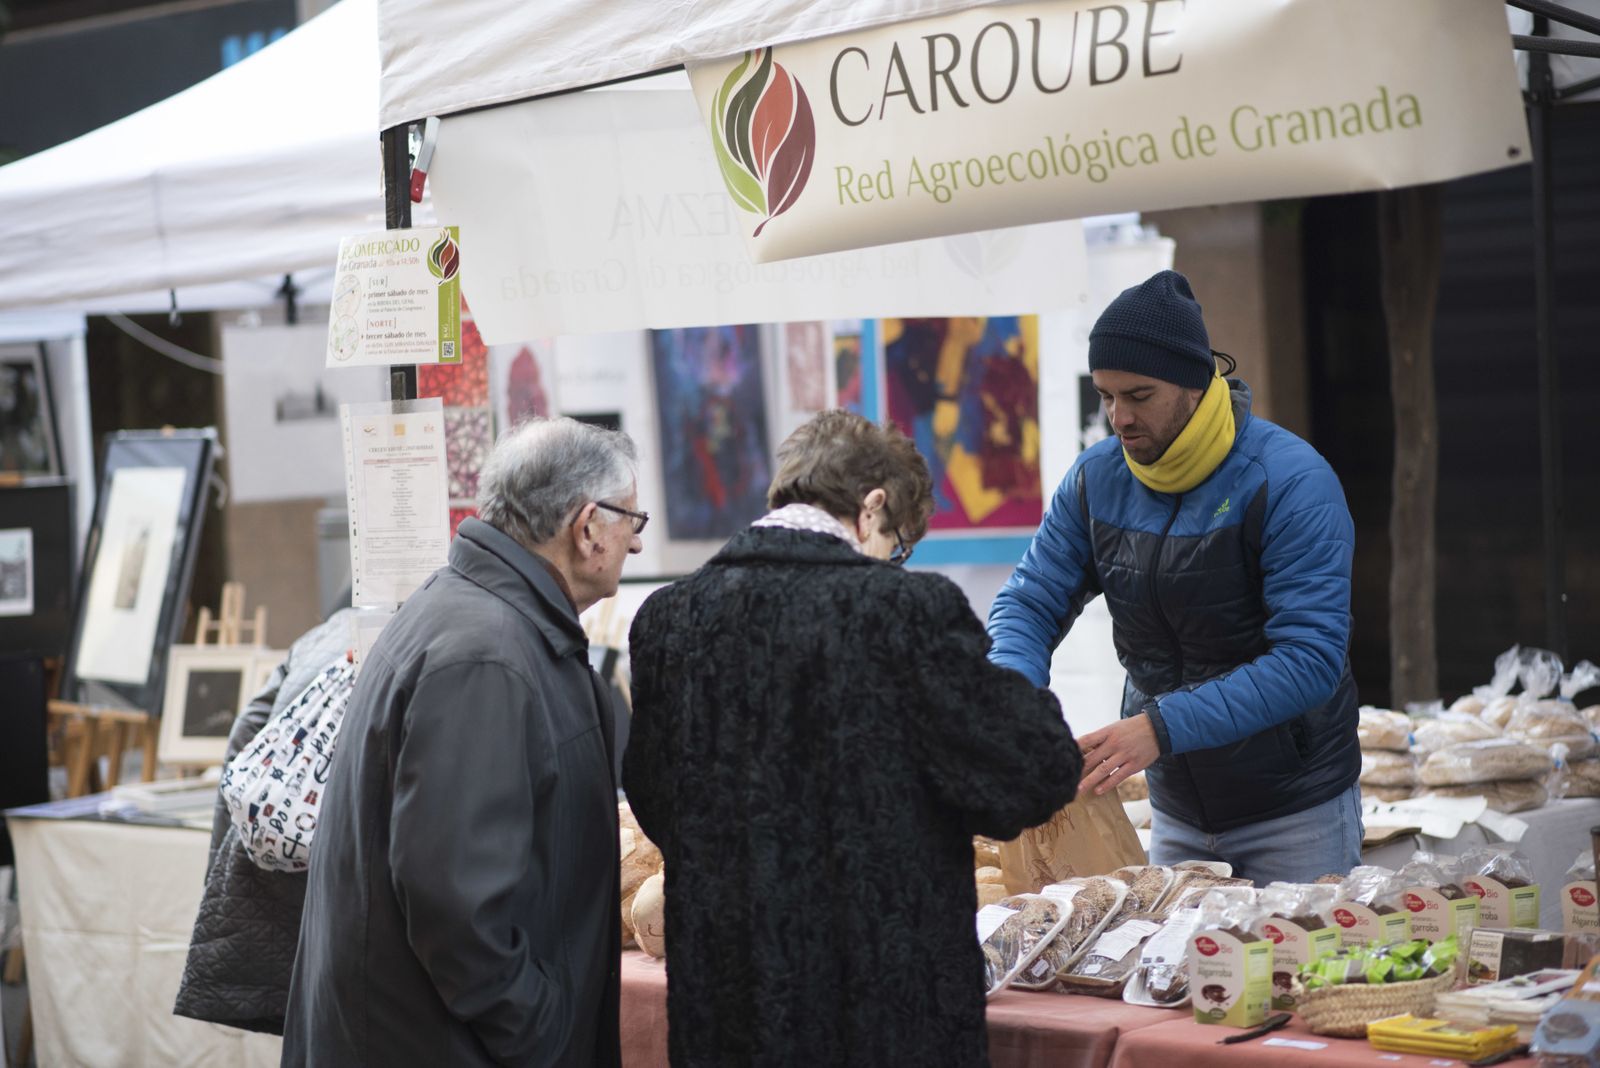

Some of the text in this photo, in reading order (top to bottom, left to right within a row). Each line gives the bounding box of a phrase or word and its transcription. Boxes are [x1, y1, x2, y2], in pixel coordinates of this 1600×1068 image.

[829, 0, 1186, 127] CAROUBE
[834, 85, 1423, 205] Red Agroecológica de Granada
[368, 290, 386, 299] primer
[408, 288, 416, 296] de
